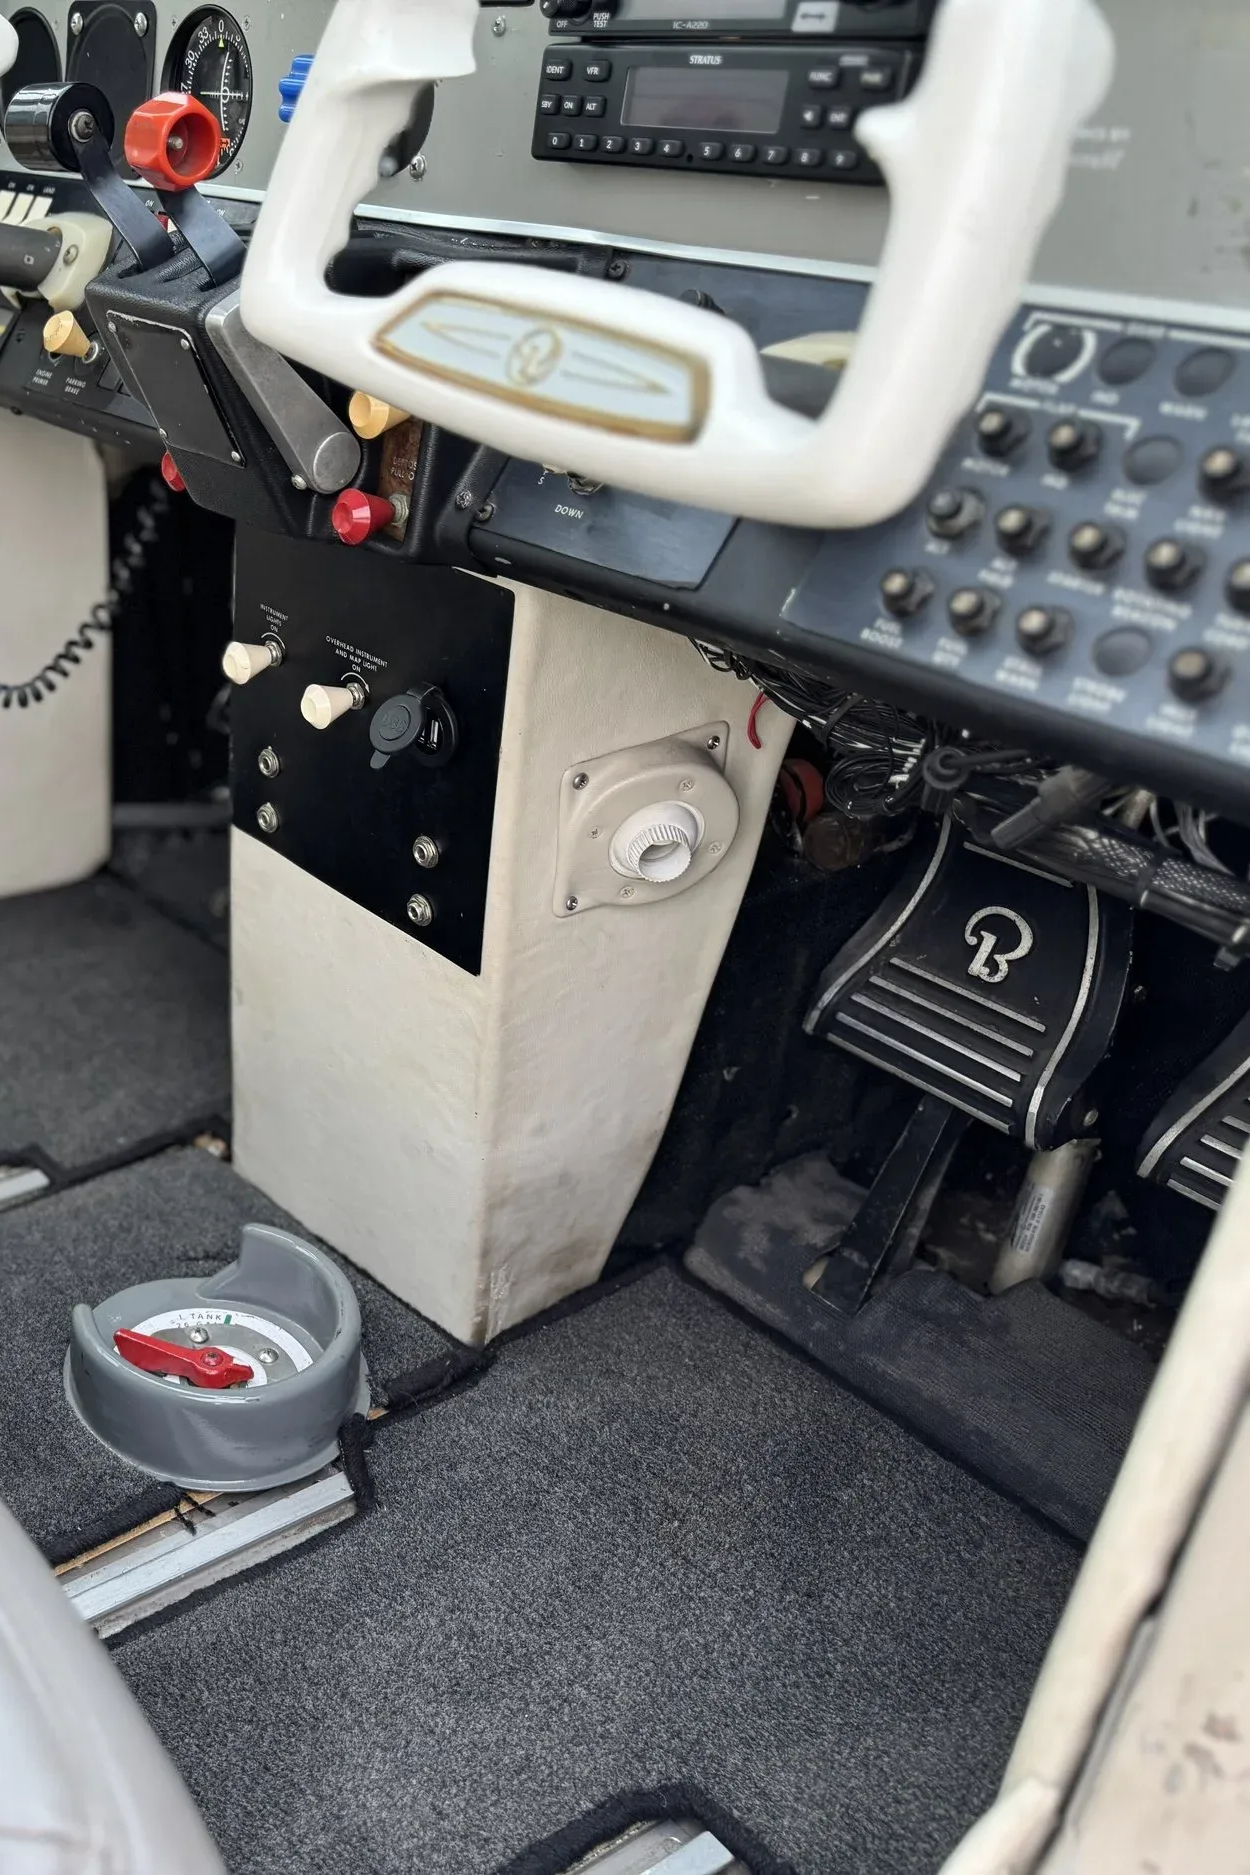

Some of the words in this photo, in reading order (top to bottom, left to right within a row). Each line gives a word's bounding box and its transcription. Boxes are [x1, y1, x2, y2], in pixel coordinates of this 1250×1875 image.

[593, 12, 610, 20] PUSH
[218, 19, 225, 33] 0
[556, 20, 568, 28] OFF
[593, 20, 608, 28] TEST
[672, 21, 709, 30] IC-A220
[198, 27, 209, 44] 33
[184, 50, 196, 69] 30
[689, 55, 722, 65] STRATUS
[546, 66, 564, 74] IDENT
[586, 66, 599, 75] VFR
[541, 100, 552, 109] SBY
[563, 101, 573, 109] ON
[586, 103, 598, 111] ALT
[552, 137, 558, 146] 0
[579, 139, 584, 148] 1
[606, 140, 613, 149] 2
[634, 142, 641, 151] 3
[663, 144, 670, 153] 4
[703, 146, 710, 156] 5
[734, 148, 742, 158] 6
[767, 150, 775, 160] 7
[800, 152, 808, 163] 8
[65, 377, 87, 389] PARKING
[64, 385, 80, 396] BRAKE
[554, 504, 585, 519] DOWN
[259, 603, 289, 621] INSTRUMENT
[266, 615, 282, 627] LIGHTS
[270, 624, 278, 633] ON
[325, 635, 355, 653] OVERHEAD
[355, 648, 388, 668] INSTRUMENT
[335, 648, 348, 658] AND
[349, 654, 362, 664] MAP
[362, 660, 378, 672] LIGHT
[351, 664, 361, 673] ON
[964, 905, 1034, 983] B
[190, 1312, 222, 1321] TANK
